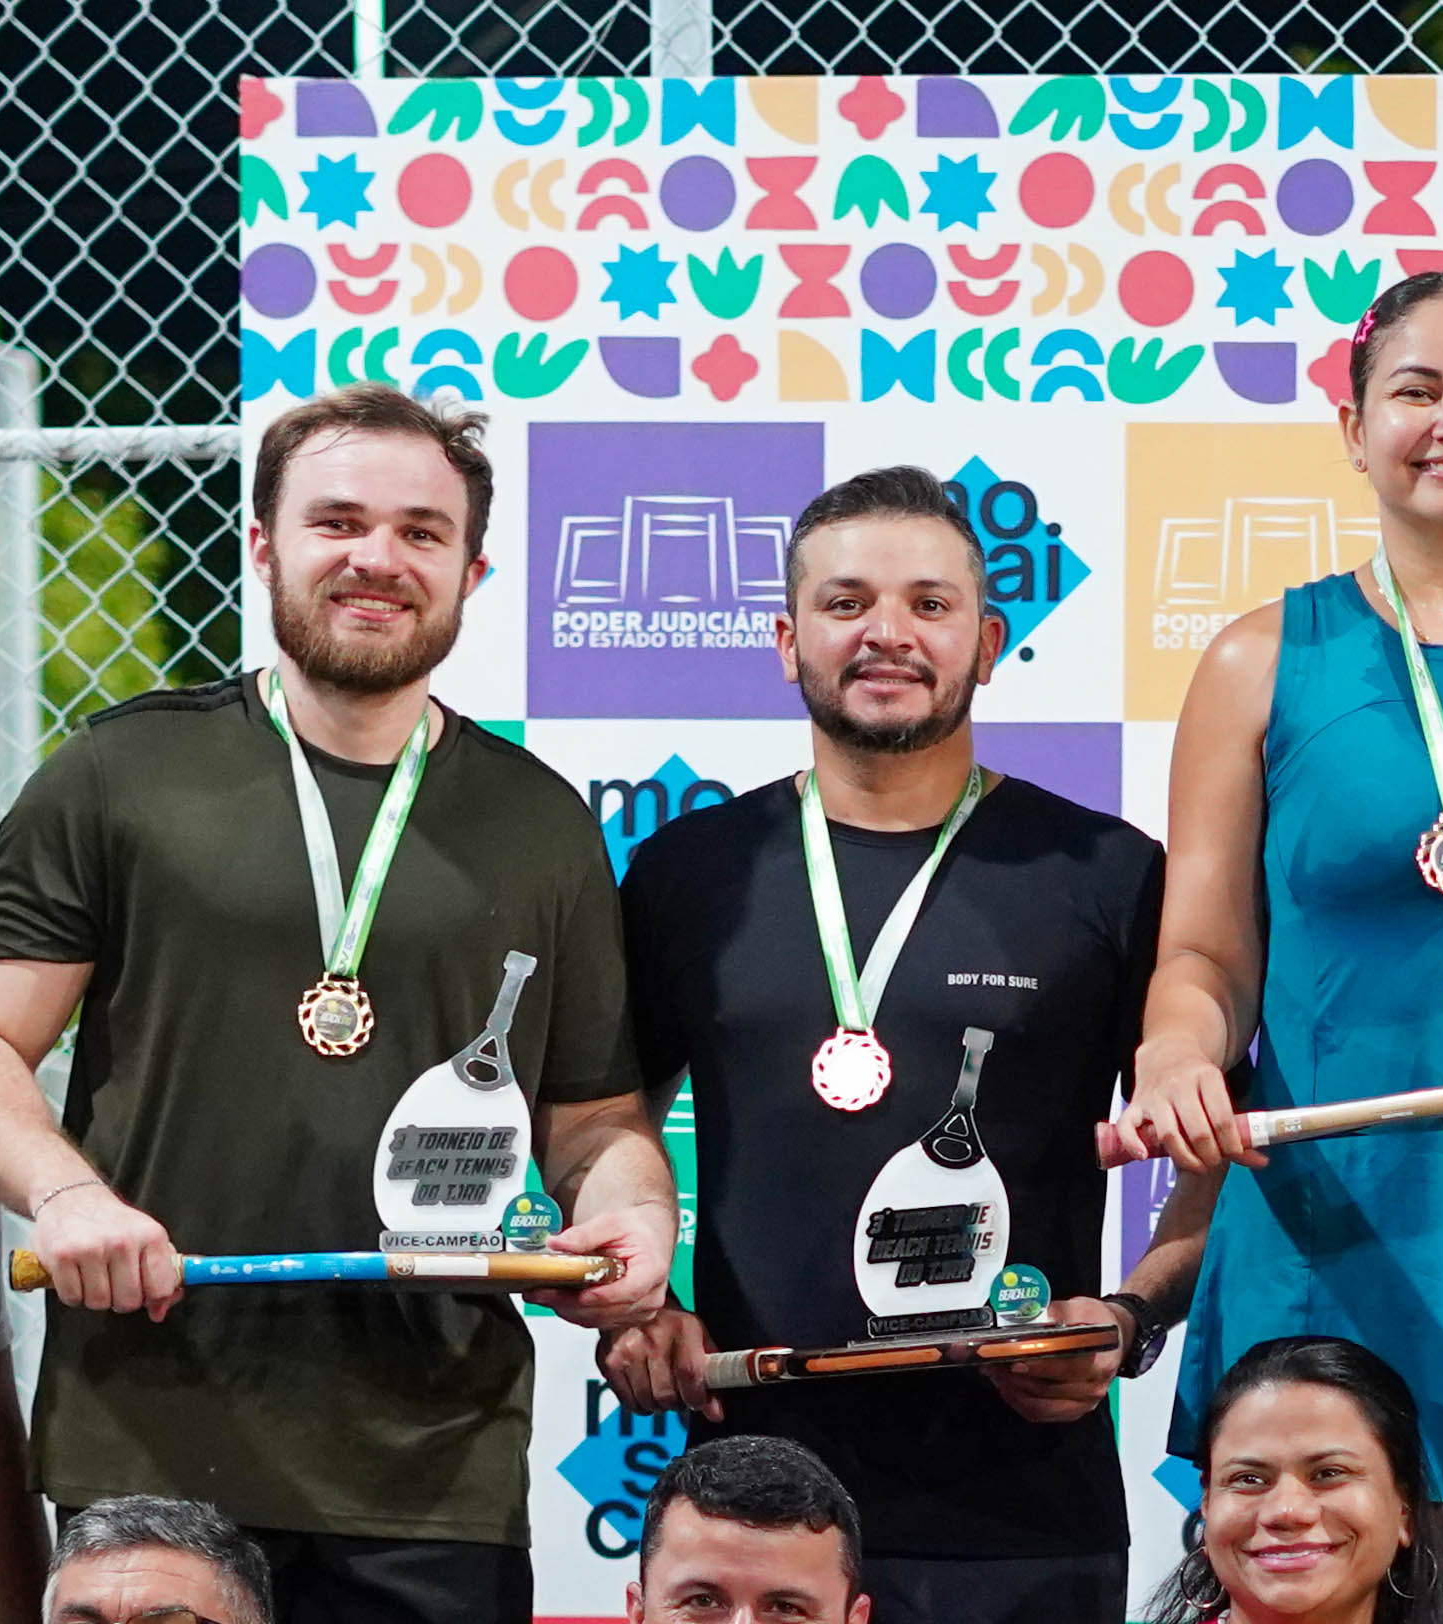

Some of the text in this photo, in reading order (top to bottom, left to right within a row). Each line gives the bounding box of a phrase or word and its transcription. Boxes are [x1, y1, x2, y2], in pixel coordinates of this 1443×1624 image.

[553, 602, 776, 633] PODER JUDICIÁRI
[553, 633, 585, 649] DO
[588, 633, 667, 649] ESTADO
[671, 632, 699, 648] DE
[1152, 633, 1185, 650] DO
[947, 974, 1038, 990] BODY FOR SURE
[418, 1132, 485, 1150] TORNEIO
[488, 1132, 513, 1150] DE
[453, 1157, 511, 1176] TENNIS
[384, 1232, 501, 1247] VICE-CAMPEÃO
